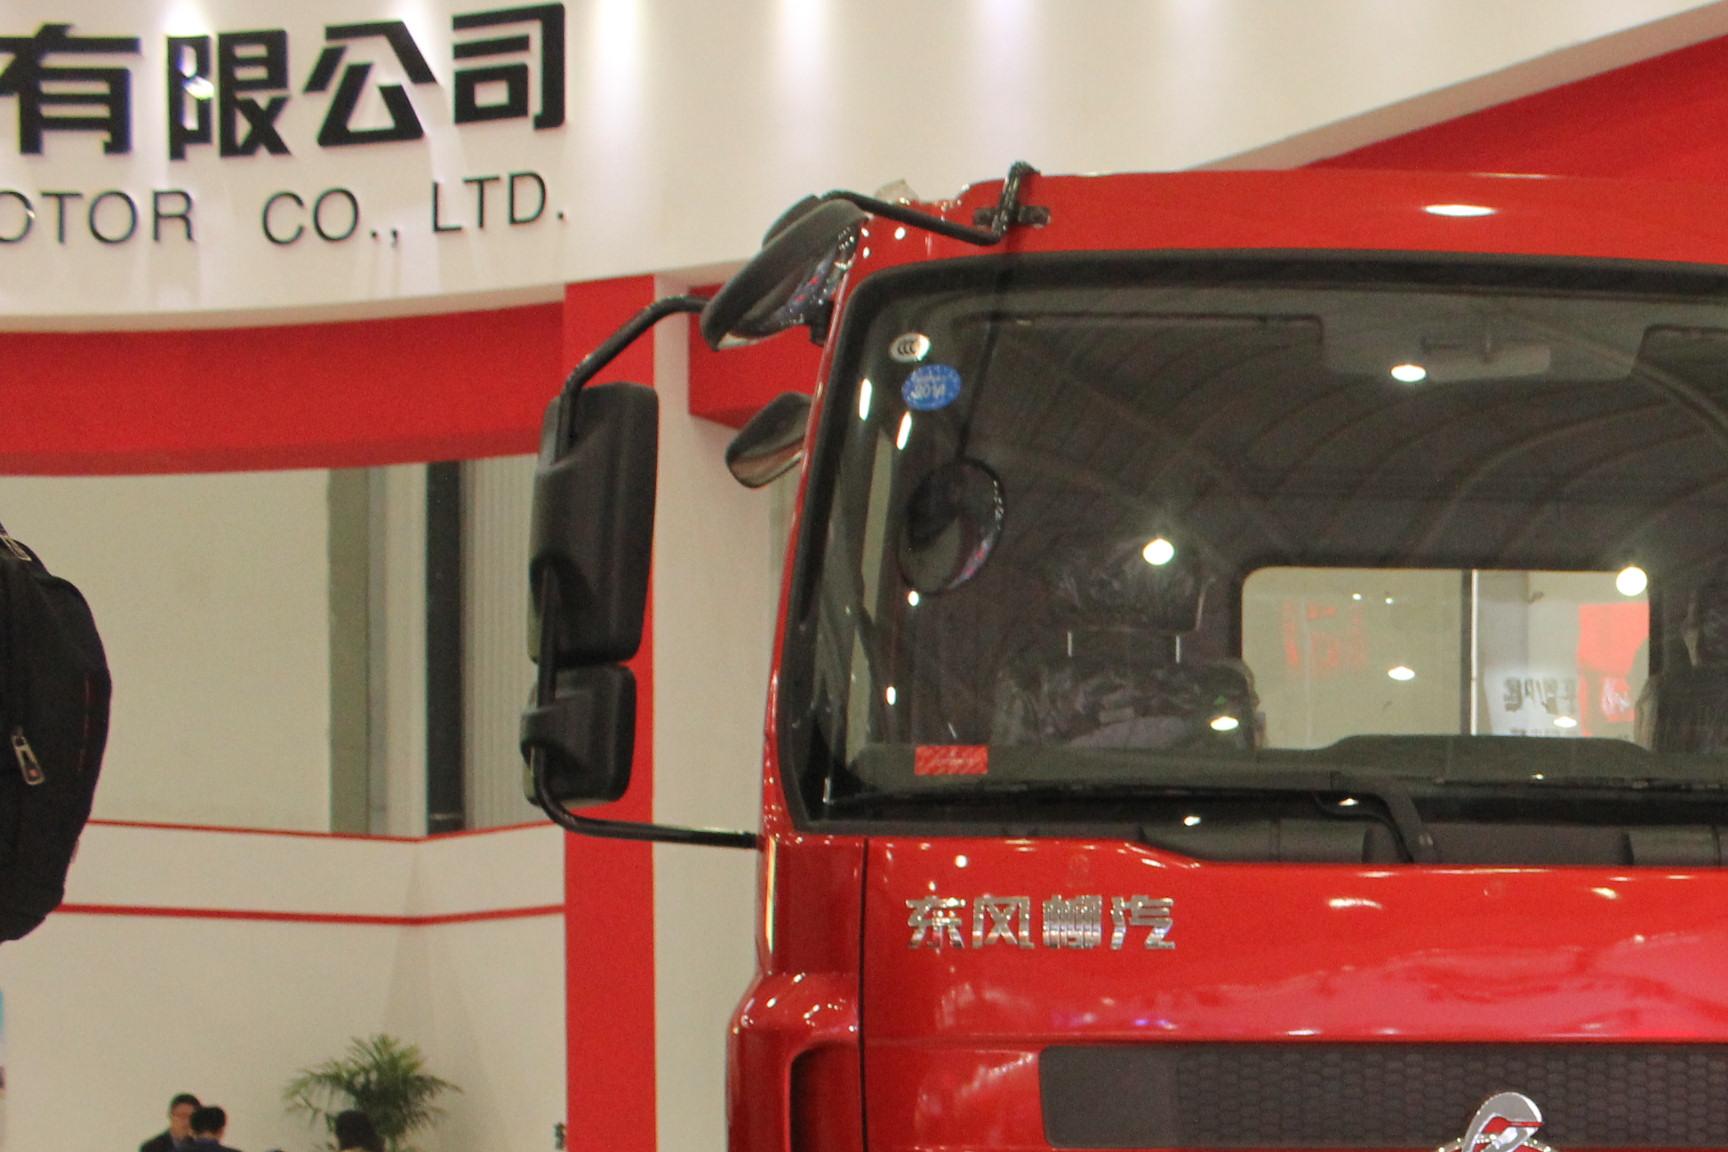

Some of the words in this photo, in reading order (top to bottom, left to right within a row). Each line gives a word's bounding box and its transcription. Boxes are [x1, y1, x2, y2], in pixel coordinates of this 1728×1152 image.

[0, 3, 566, 159] 有限公司
[261, 188, 399, 248] CO.,
[431, 171, 566, 234] LTD.
